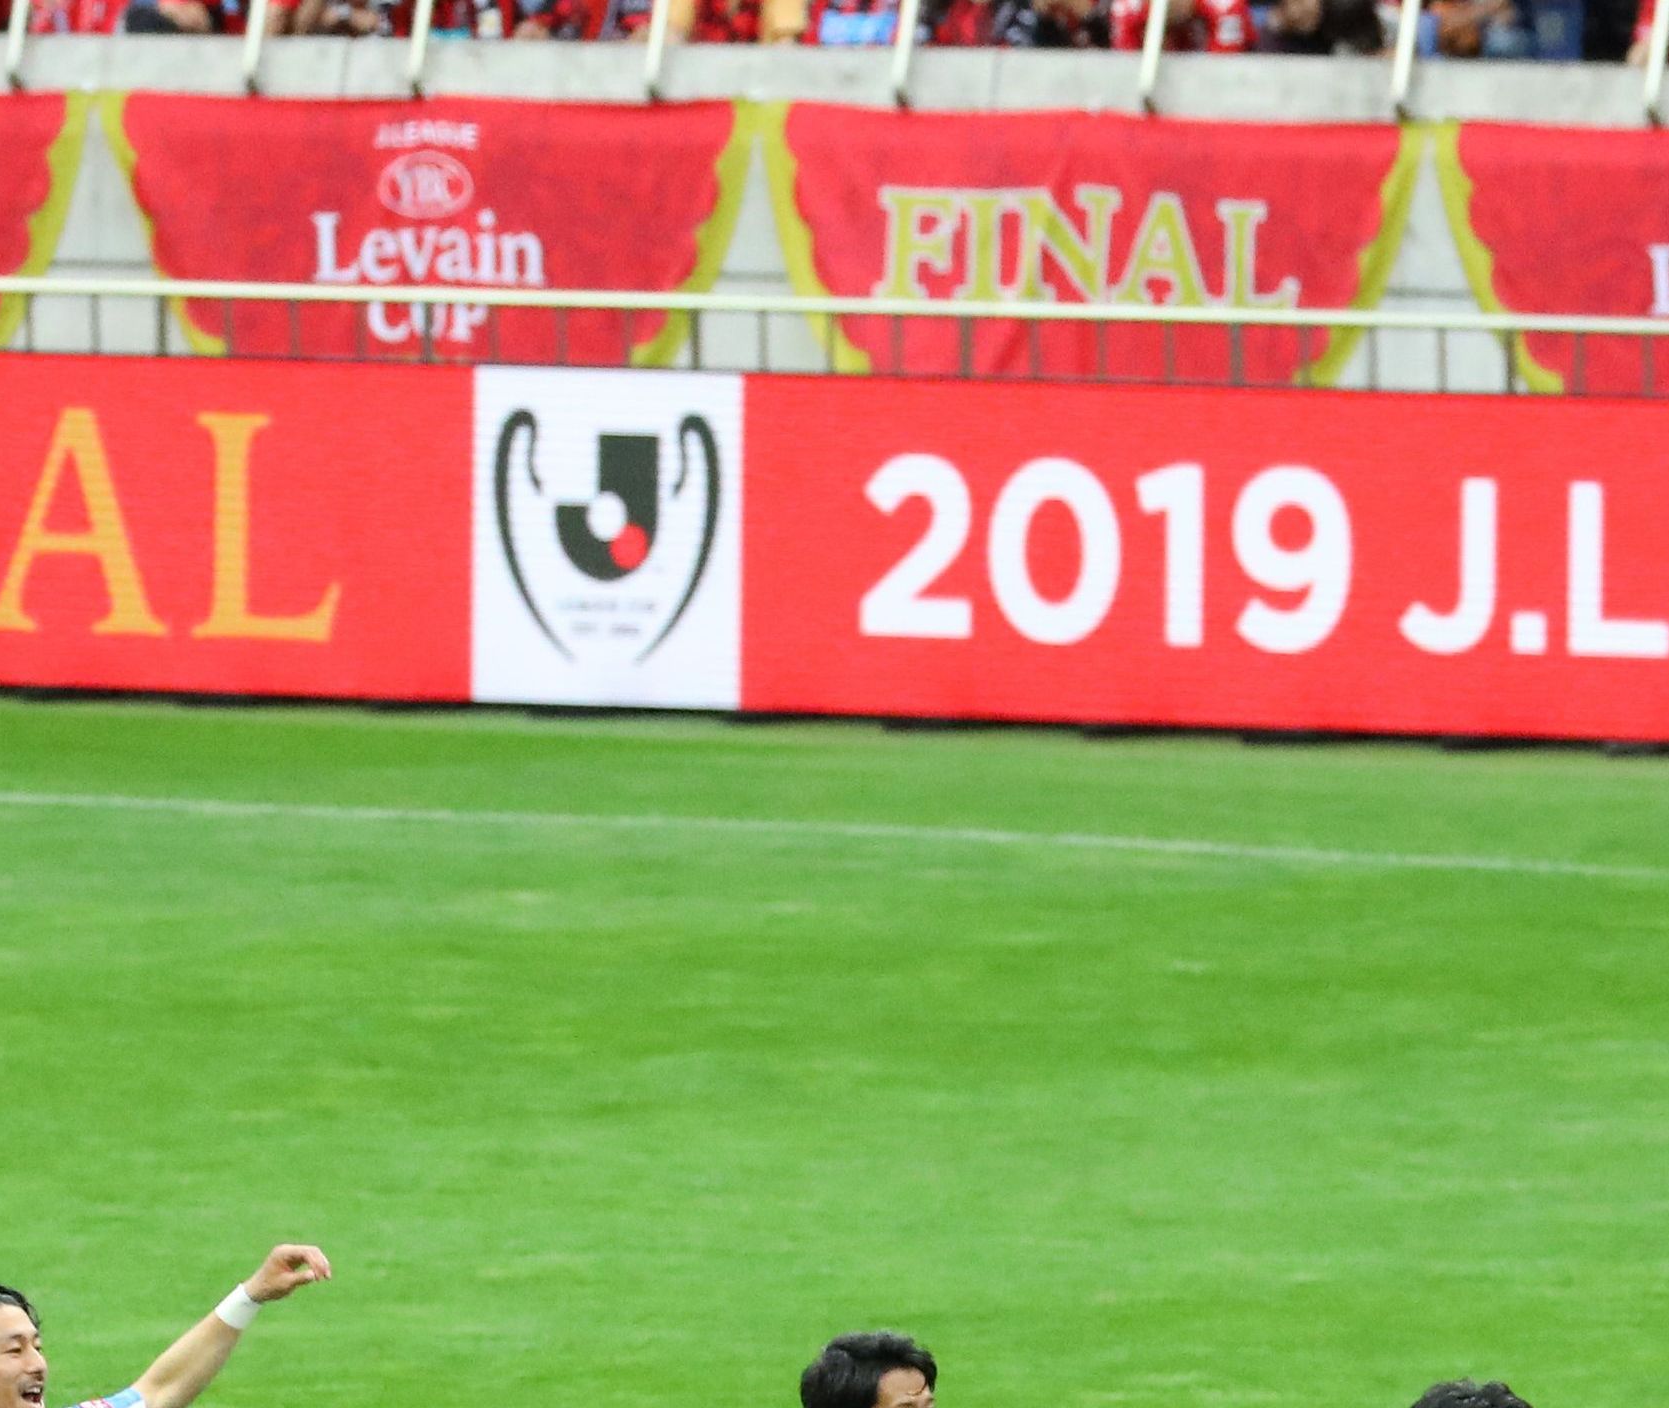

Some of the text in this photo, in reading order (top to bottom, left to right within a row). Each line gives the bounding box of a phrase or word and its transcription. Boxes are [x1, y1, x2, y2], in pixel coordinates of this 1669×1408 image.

[310, 207, 547, 288] Levain
[870, 184, 1300, 310] FINAL
[367, 298, 489, 343] CUP
[858, 453, 1353, 654] 2019
